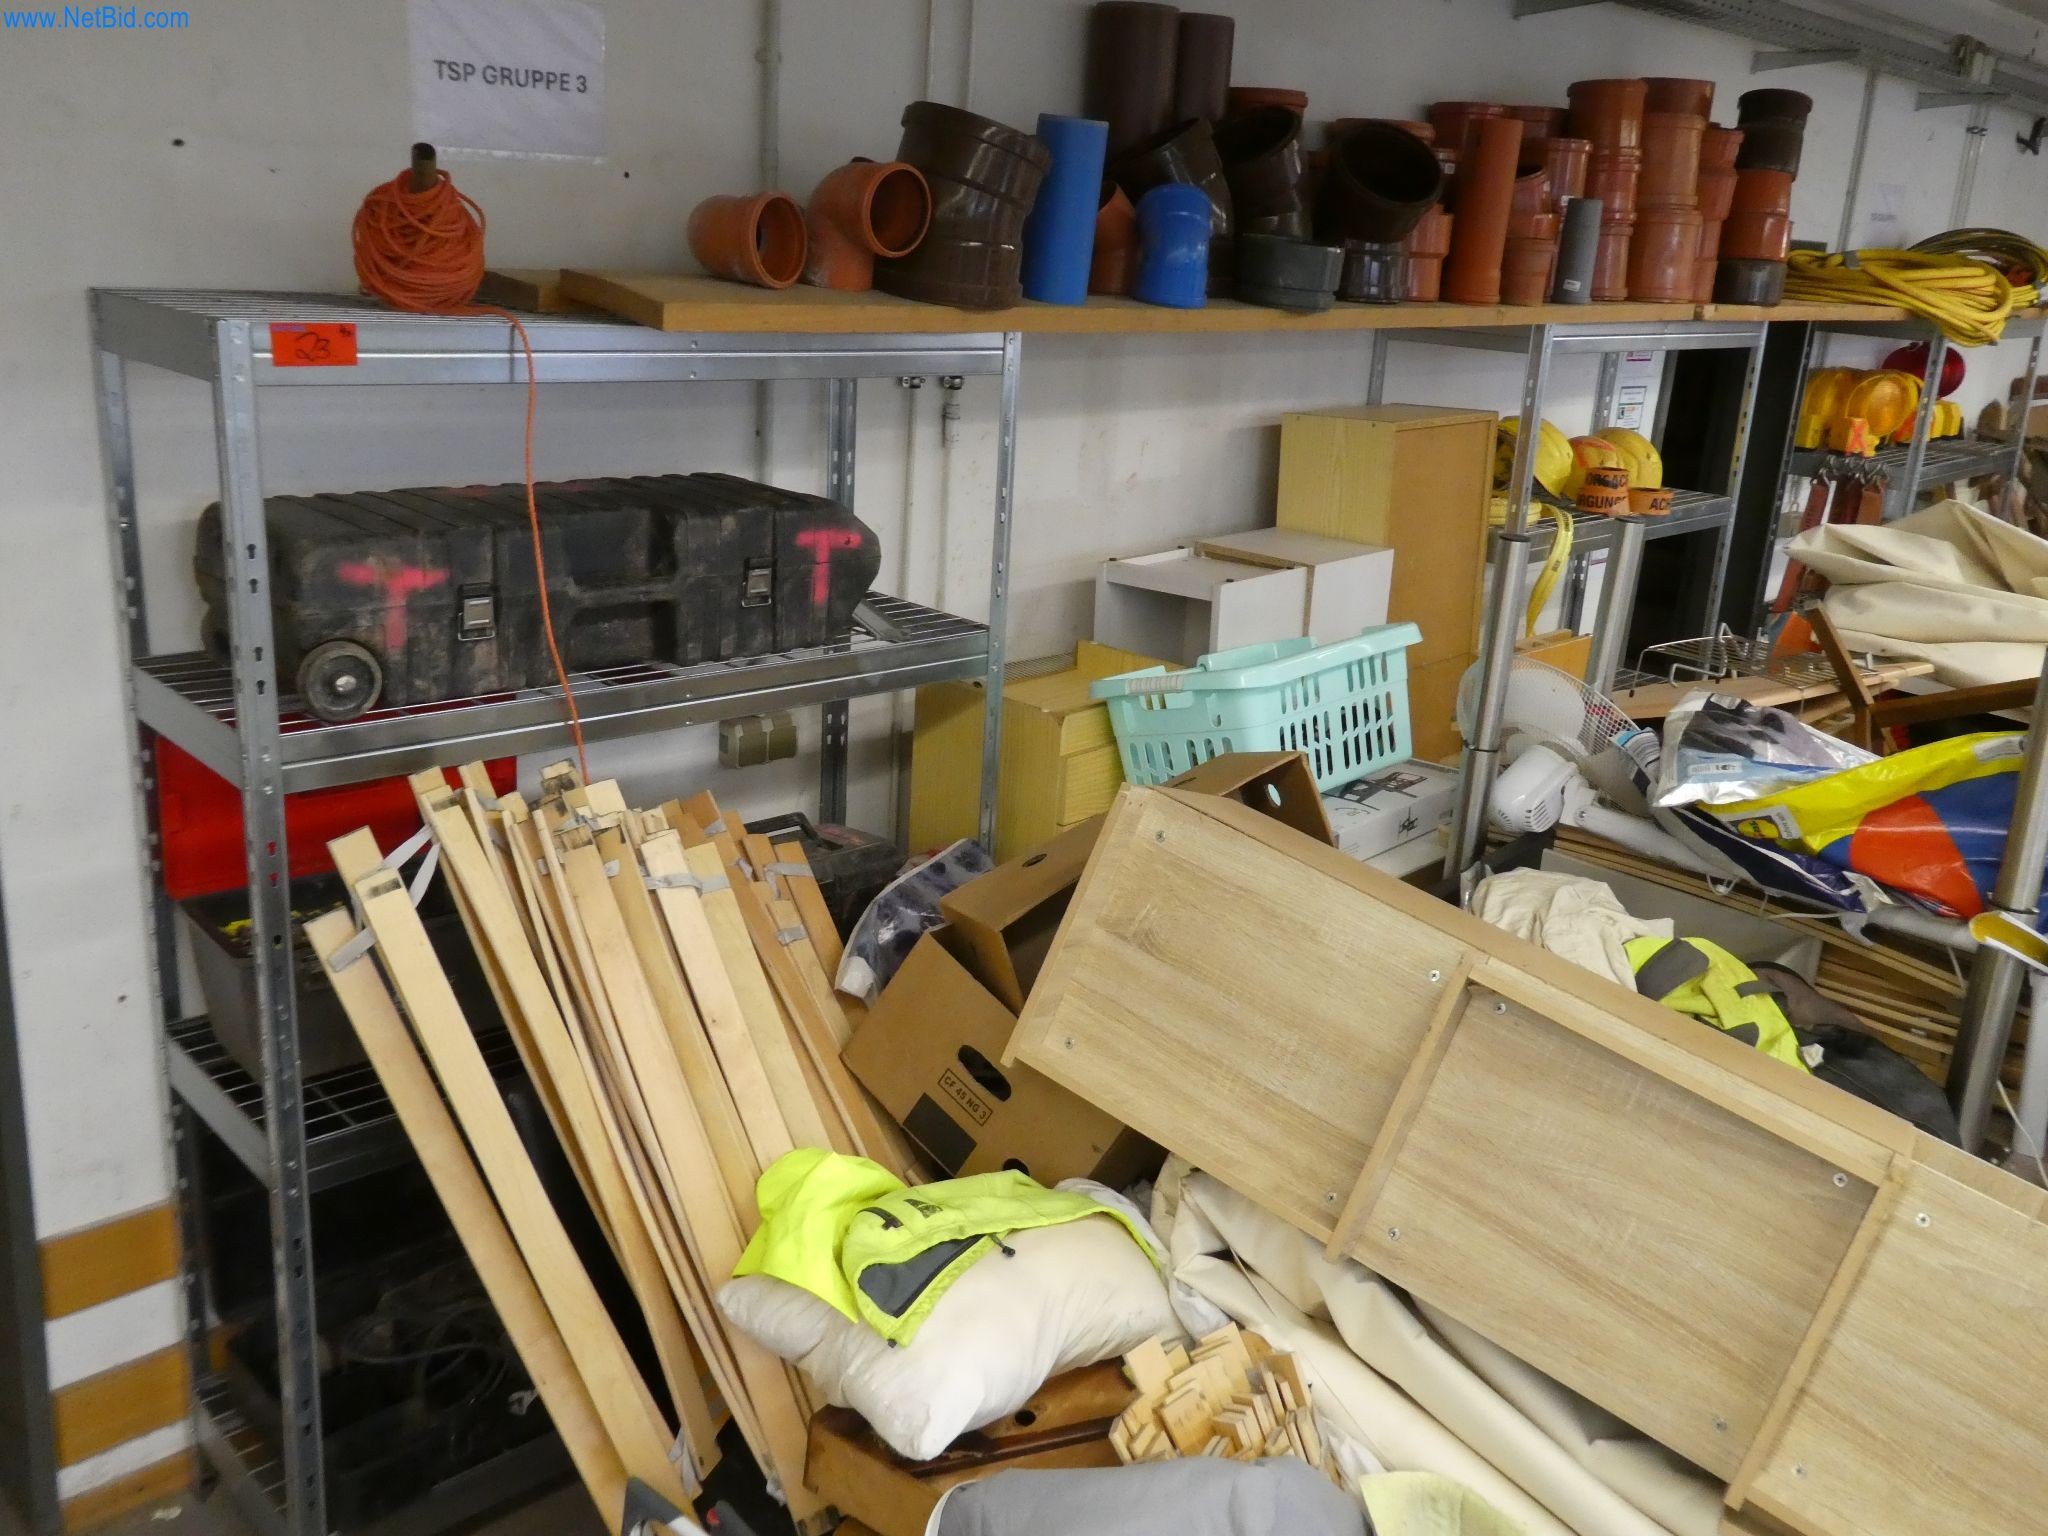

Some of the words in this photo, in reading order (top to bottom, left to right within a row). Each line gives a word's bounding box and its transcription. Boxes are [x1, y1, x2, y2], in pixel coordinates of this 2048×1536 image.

[434, 60, 476, 82] TSP
[482, 65, 571, 92] GRUPPE
[576, 75, 588, 94] 3
[795, 530, 862, 606] T
[338, 562, 450, 651] T
[944, 1075, 956, 1087] CF
[955, 1087, 968, 1100] 45
[966, 1098, 980, 1113] NG
[979, 1110, 987, 1120] 3
